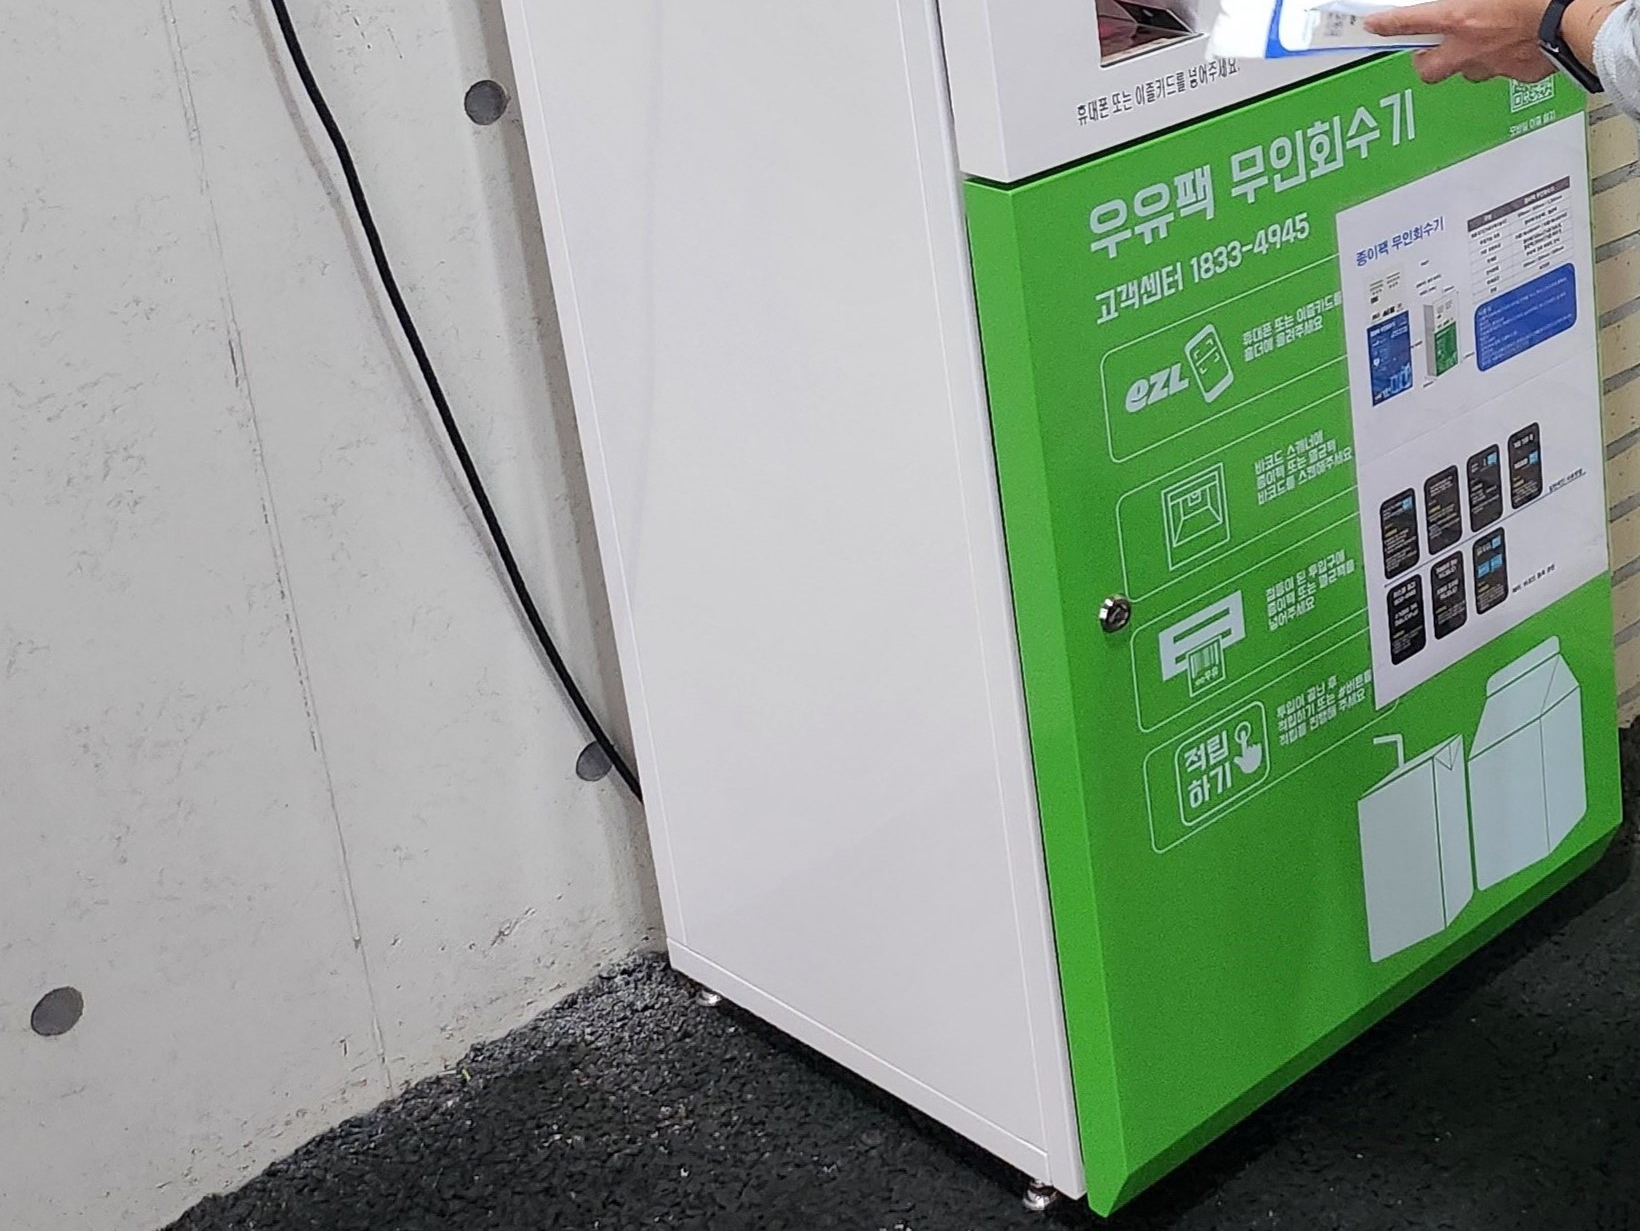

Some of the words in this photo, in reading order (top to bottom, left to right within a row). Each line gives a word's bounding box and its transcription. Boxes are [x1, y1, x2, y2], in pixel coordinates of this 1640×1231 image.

[1077, 96, 1109, 126] 휴대폰
[1112, 90, 1133, 114] 또는
[1135, 71, 1187, 106] 이즐카드를
[1088, 164, 1216, 259] 우유팩
[1230, 88, 1417, 206] 무인회수기
[1355, 239, 1389, 268] 종이팩
[1391, 215, 1445, 250] 무인회수기
[1094, 262, 1186, 325] 고객센터
[1190, 212, 1311, 283] 1833-4945
[1274, 314, 1295, 333] 또는
[1254, 449, 1285, 476] 바코드
[1287, 455, 1307, 475] 또는
[1297, 581, 1317, 602] 또는
[1316, 693, 1336, 712] 또는
[1184, 729, 1230, 773] 적립
[1187, 760, 1232, 809] 하기
